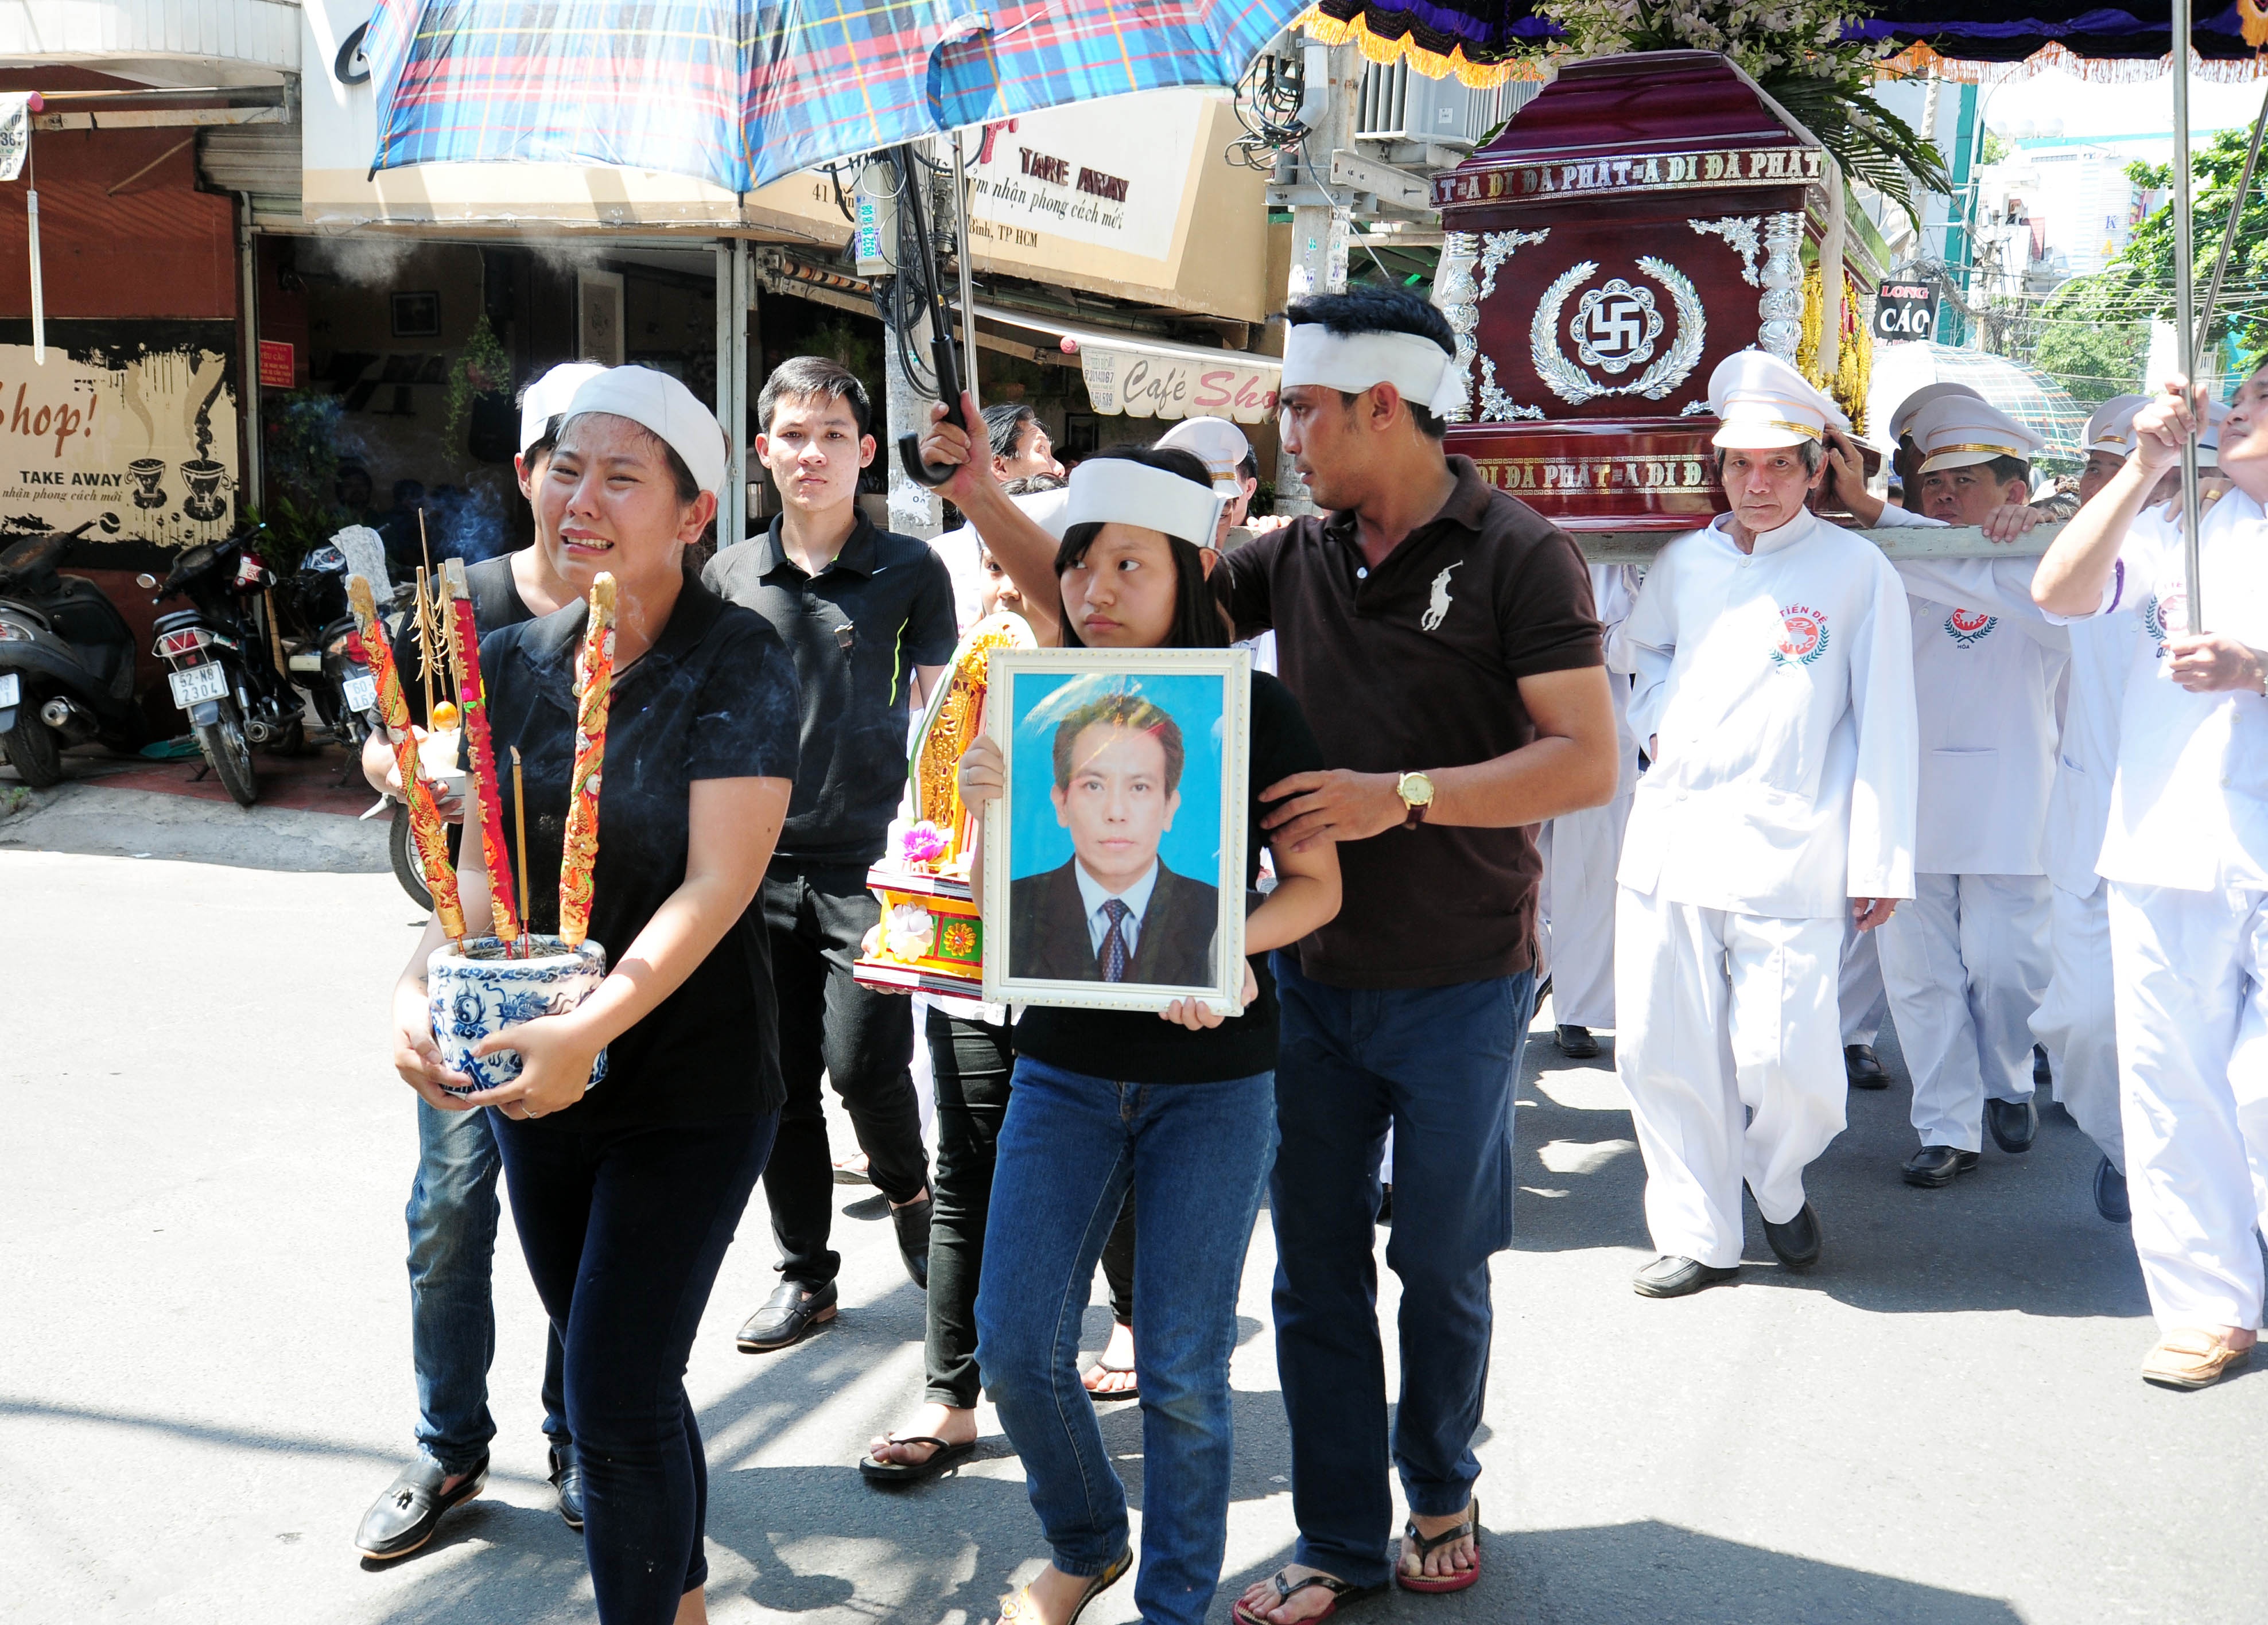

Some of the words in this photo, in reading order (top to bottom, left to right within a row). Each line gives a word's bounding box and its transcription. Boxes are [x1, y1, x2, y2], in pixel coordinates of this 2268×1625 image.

[1019, 147, 1070, 186] TAKE
[1076, 167, 1130, 202] AWAY
[1466, 176, 1481, 199] A
[1642, 158, 1660, 183] A
[1666, 155, 1698, 182] DI
[1704, 151, 1742, 180] ĐÀ
[1749, 150, 1822, 179] PHẬT
[812, 183, 828, 203] 41
[992, 177, 1027, 209] nhận
[1029, 188, 1069, 220] phong
[1071, 199, 1098, 224] cách
[1101, 207, 1124, 230] mới
[861, 205, 873, 215] 08
[863, 237, 875, 256] 0932
[997, 224, 1012, 242] TP
[1016, 228, 1038, 248] HCM
[1881, 285, 1929, 299] LONG
[1880, 301, 1931, 333] CÁO
[1123, 359, 1187, 412] Café
[1194, 371, 1277, 409] Sho
[0, 381, 97, 458] hop!
[20, 471, 65, 485] TAKE
[71, 472, 122, 487] AWAY
[1622, 463, 1640, 487] A
[1645, 462, 1676, 487] DI
[2, 486, 30, 501] nhận
[32, 487, 68, 503] phong
[71, 489, 97, 502] cách
[100, 491, 123, 502] mới
[182, 682, 218, 702] 2304
